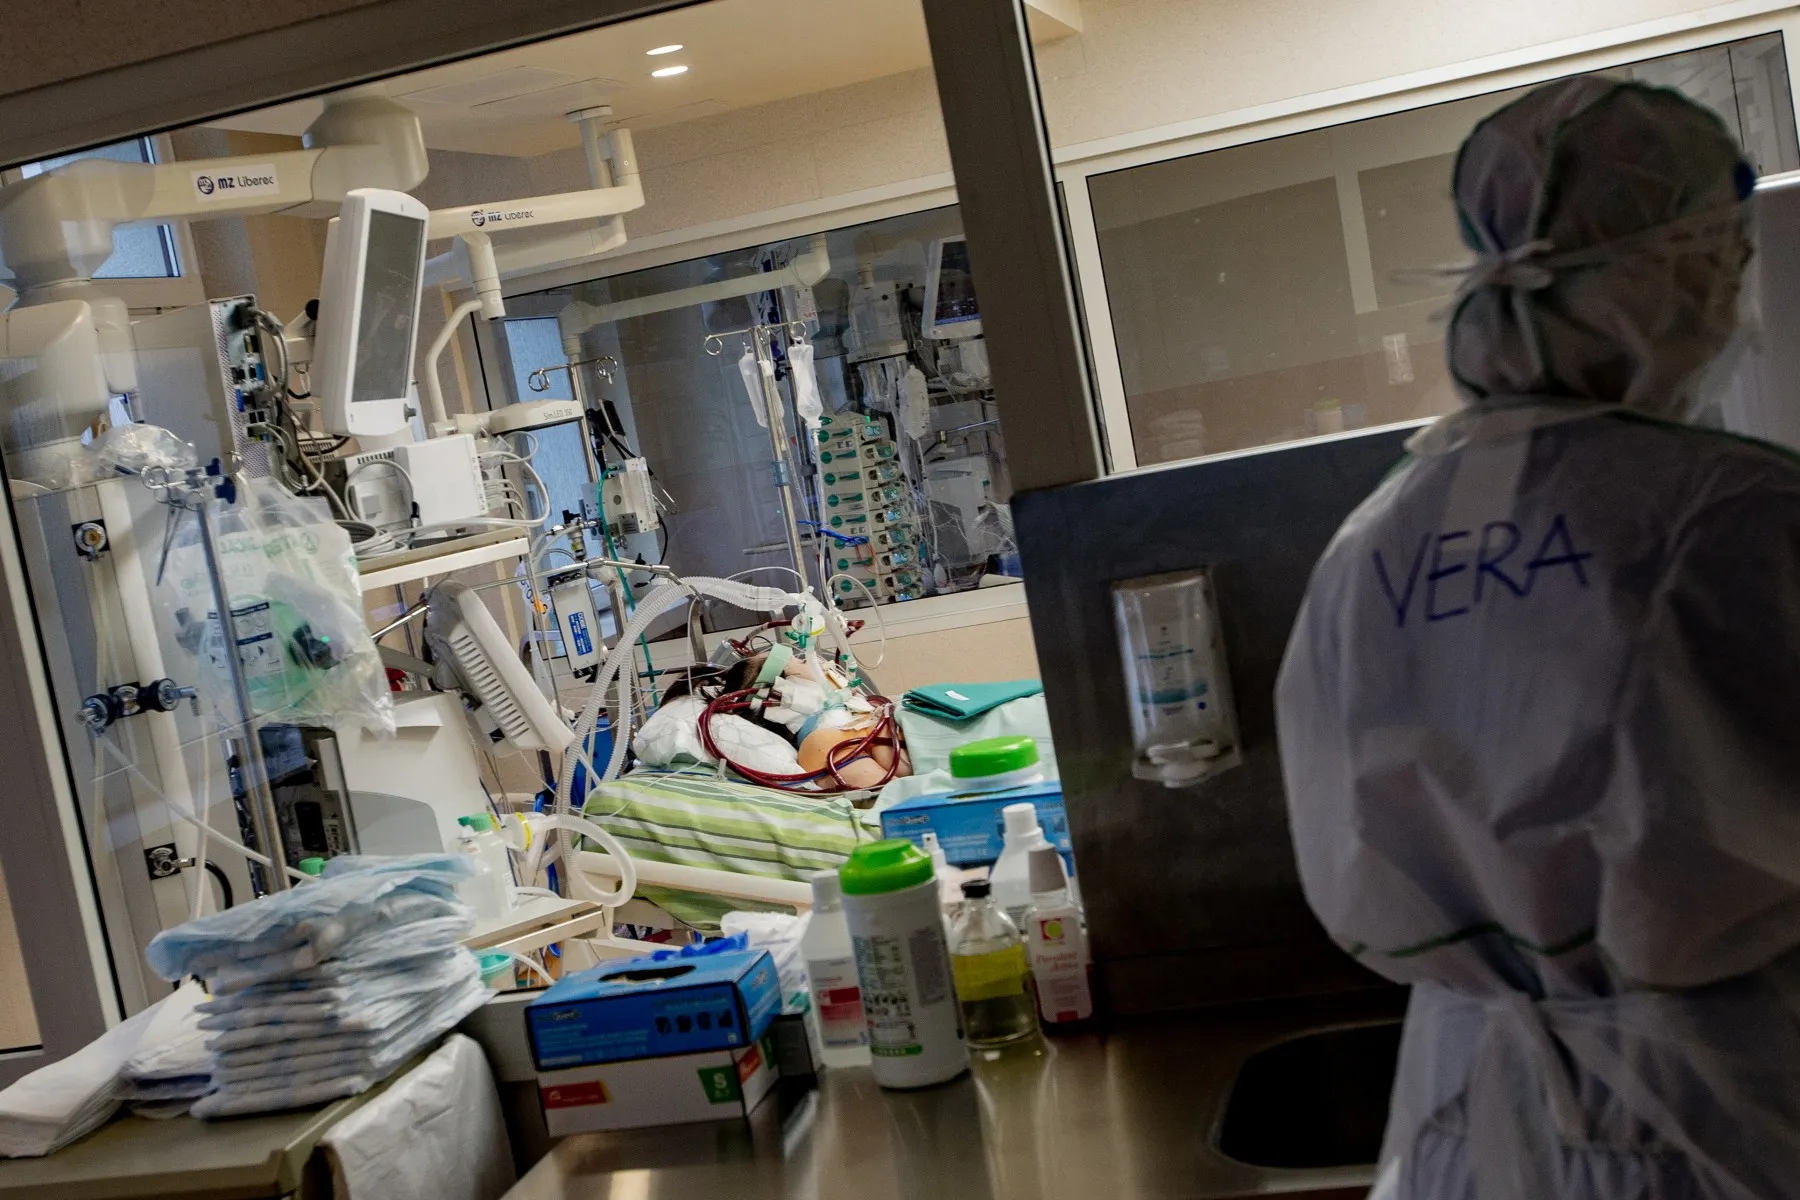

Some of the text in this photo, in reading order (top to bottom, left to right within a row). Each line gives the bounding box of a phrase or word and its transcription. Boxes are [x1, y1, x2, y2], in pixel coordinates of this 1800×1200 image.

[237, 175, 274, 187] Liberec
[1372, 513, 1594, 628] VERA
[713, 1072, 728, 1089] S
